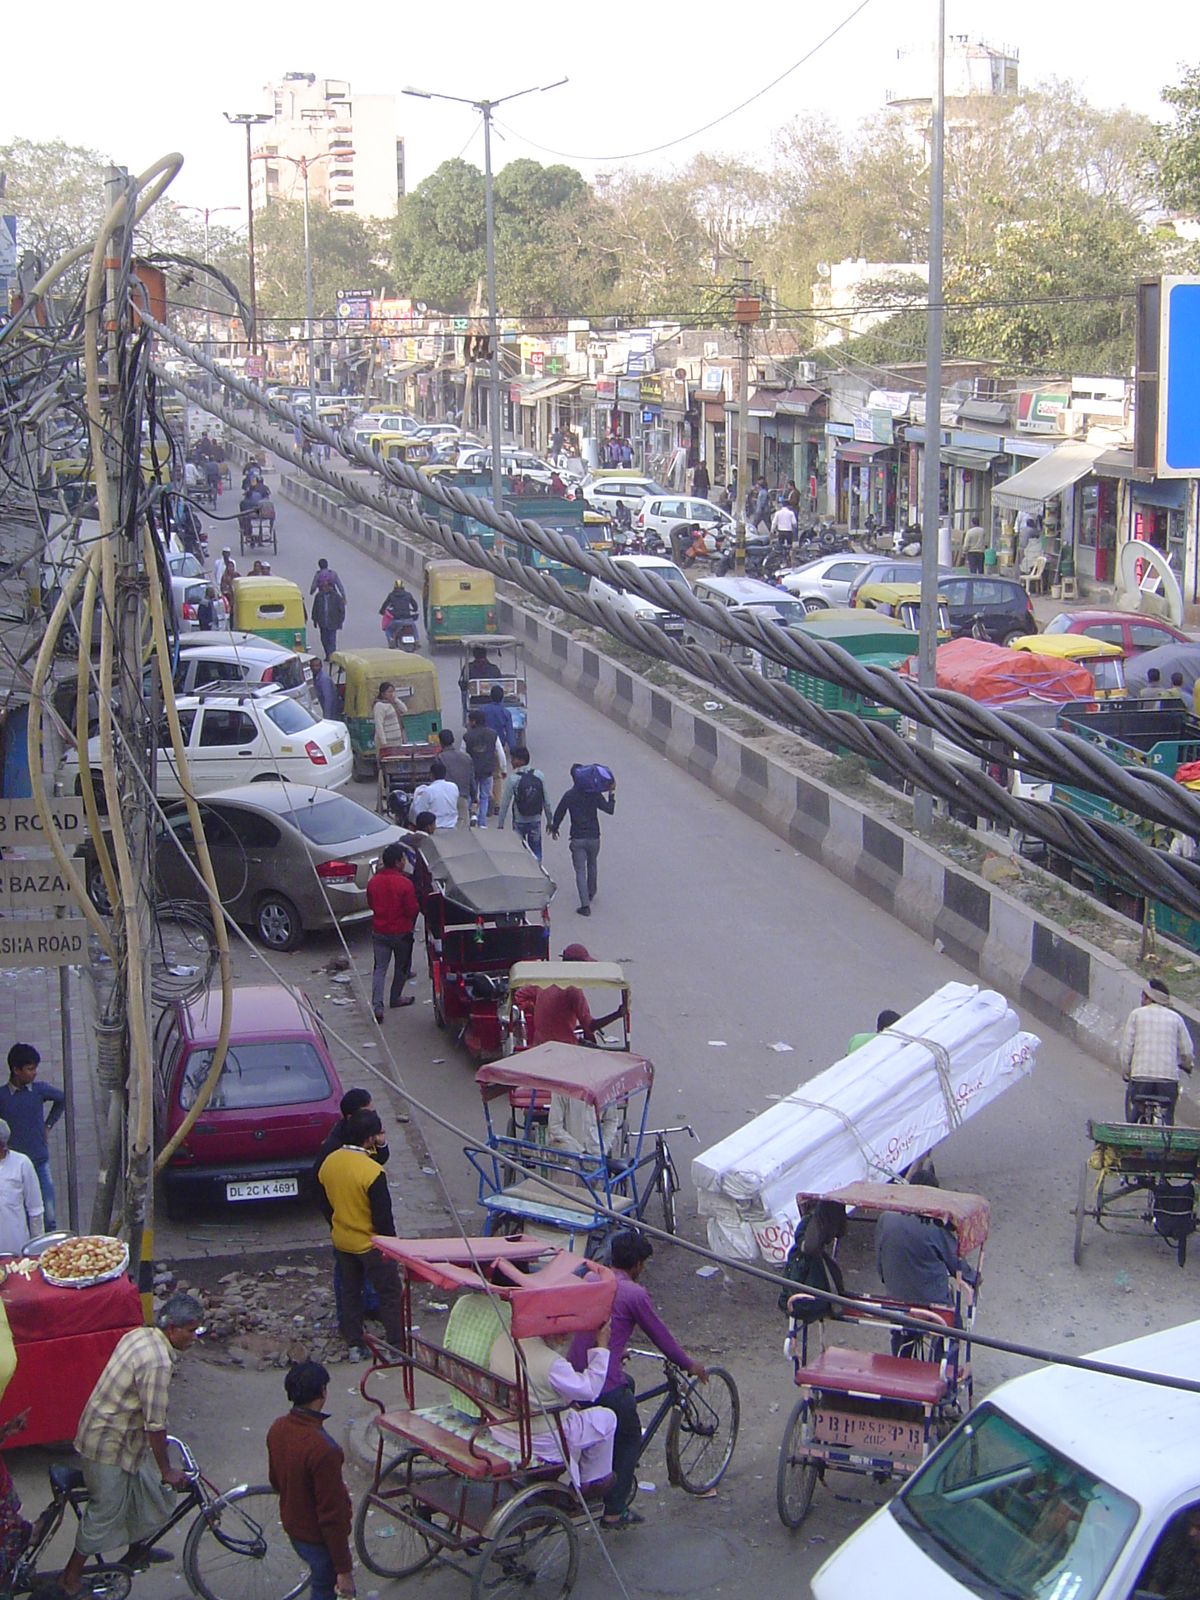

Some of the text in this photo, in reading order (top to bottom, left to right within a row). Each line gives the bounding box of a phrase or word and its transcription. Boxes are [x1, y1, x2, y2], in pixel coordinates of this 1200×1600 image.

[532, 354, 543, 364] 62
[15, 814, 78, 831] ROAD
[0, 935, 82, 954] SHA ROAD
[230, 1182, 296, 1197] DL 2C K 4691
